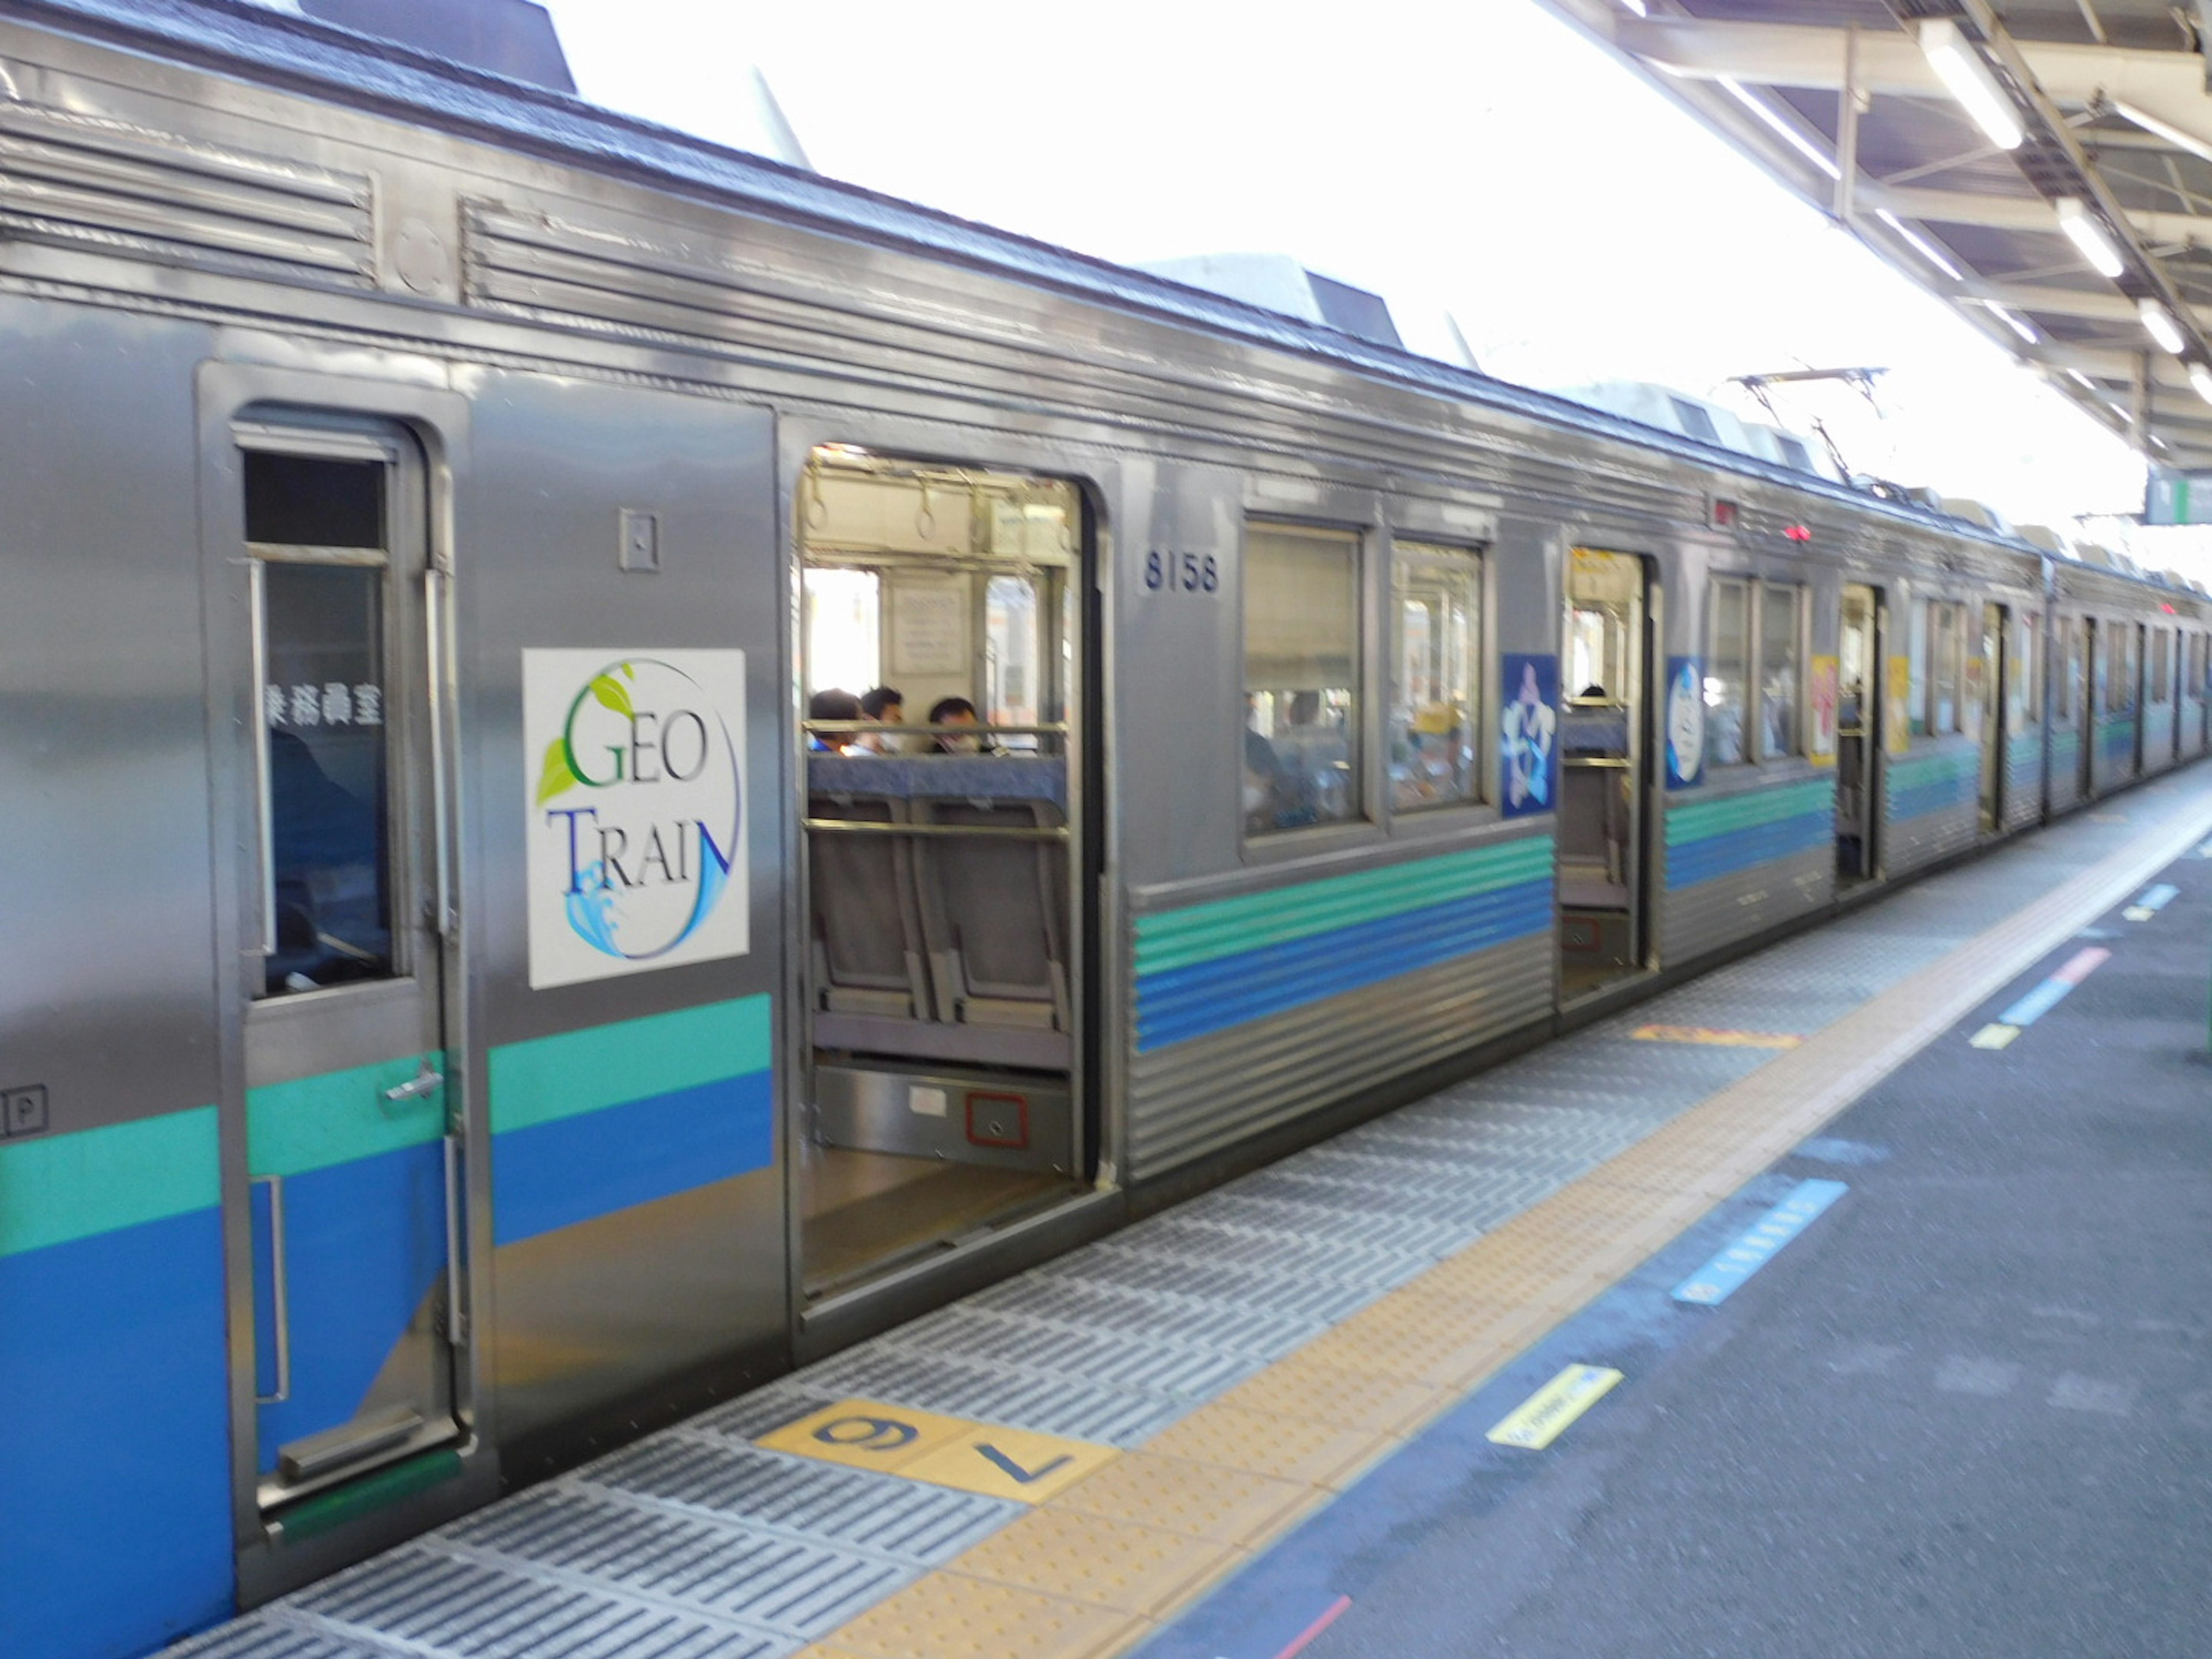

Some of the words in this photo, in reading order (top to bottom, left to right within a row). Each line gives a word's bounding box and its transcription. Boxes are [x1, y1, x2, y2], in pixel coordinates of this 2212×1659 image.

[1145, 550, 1218, 592] 8158
[563, 674, 707, 787] GEO
[546, 806, 730, 900] TRAIN
